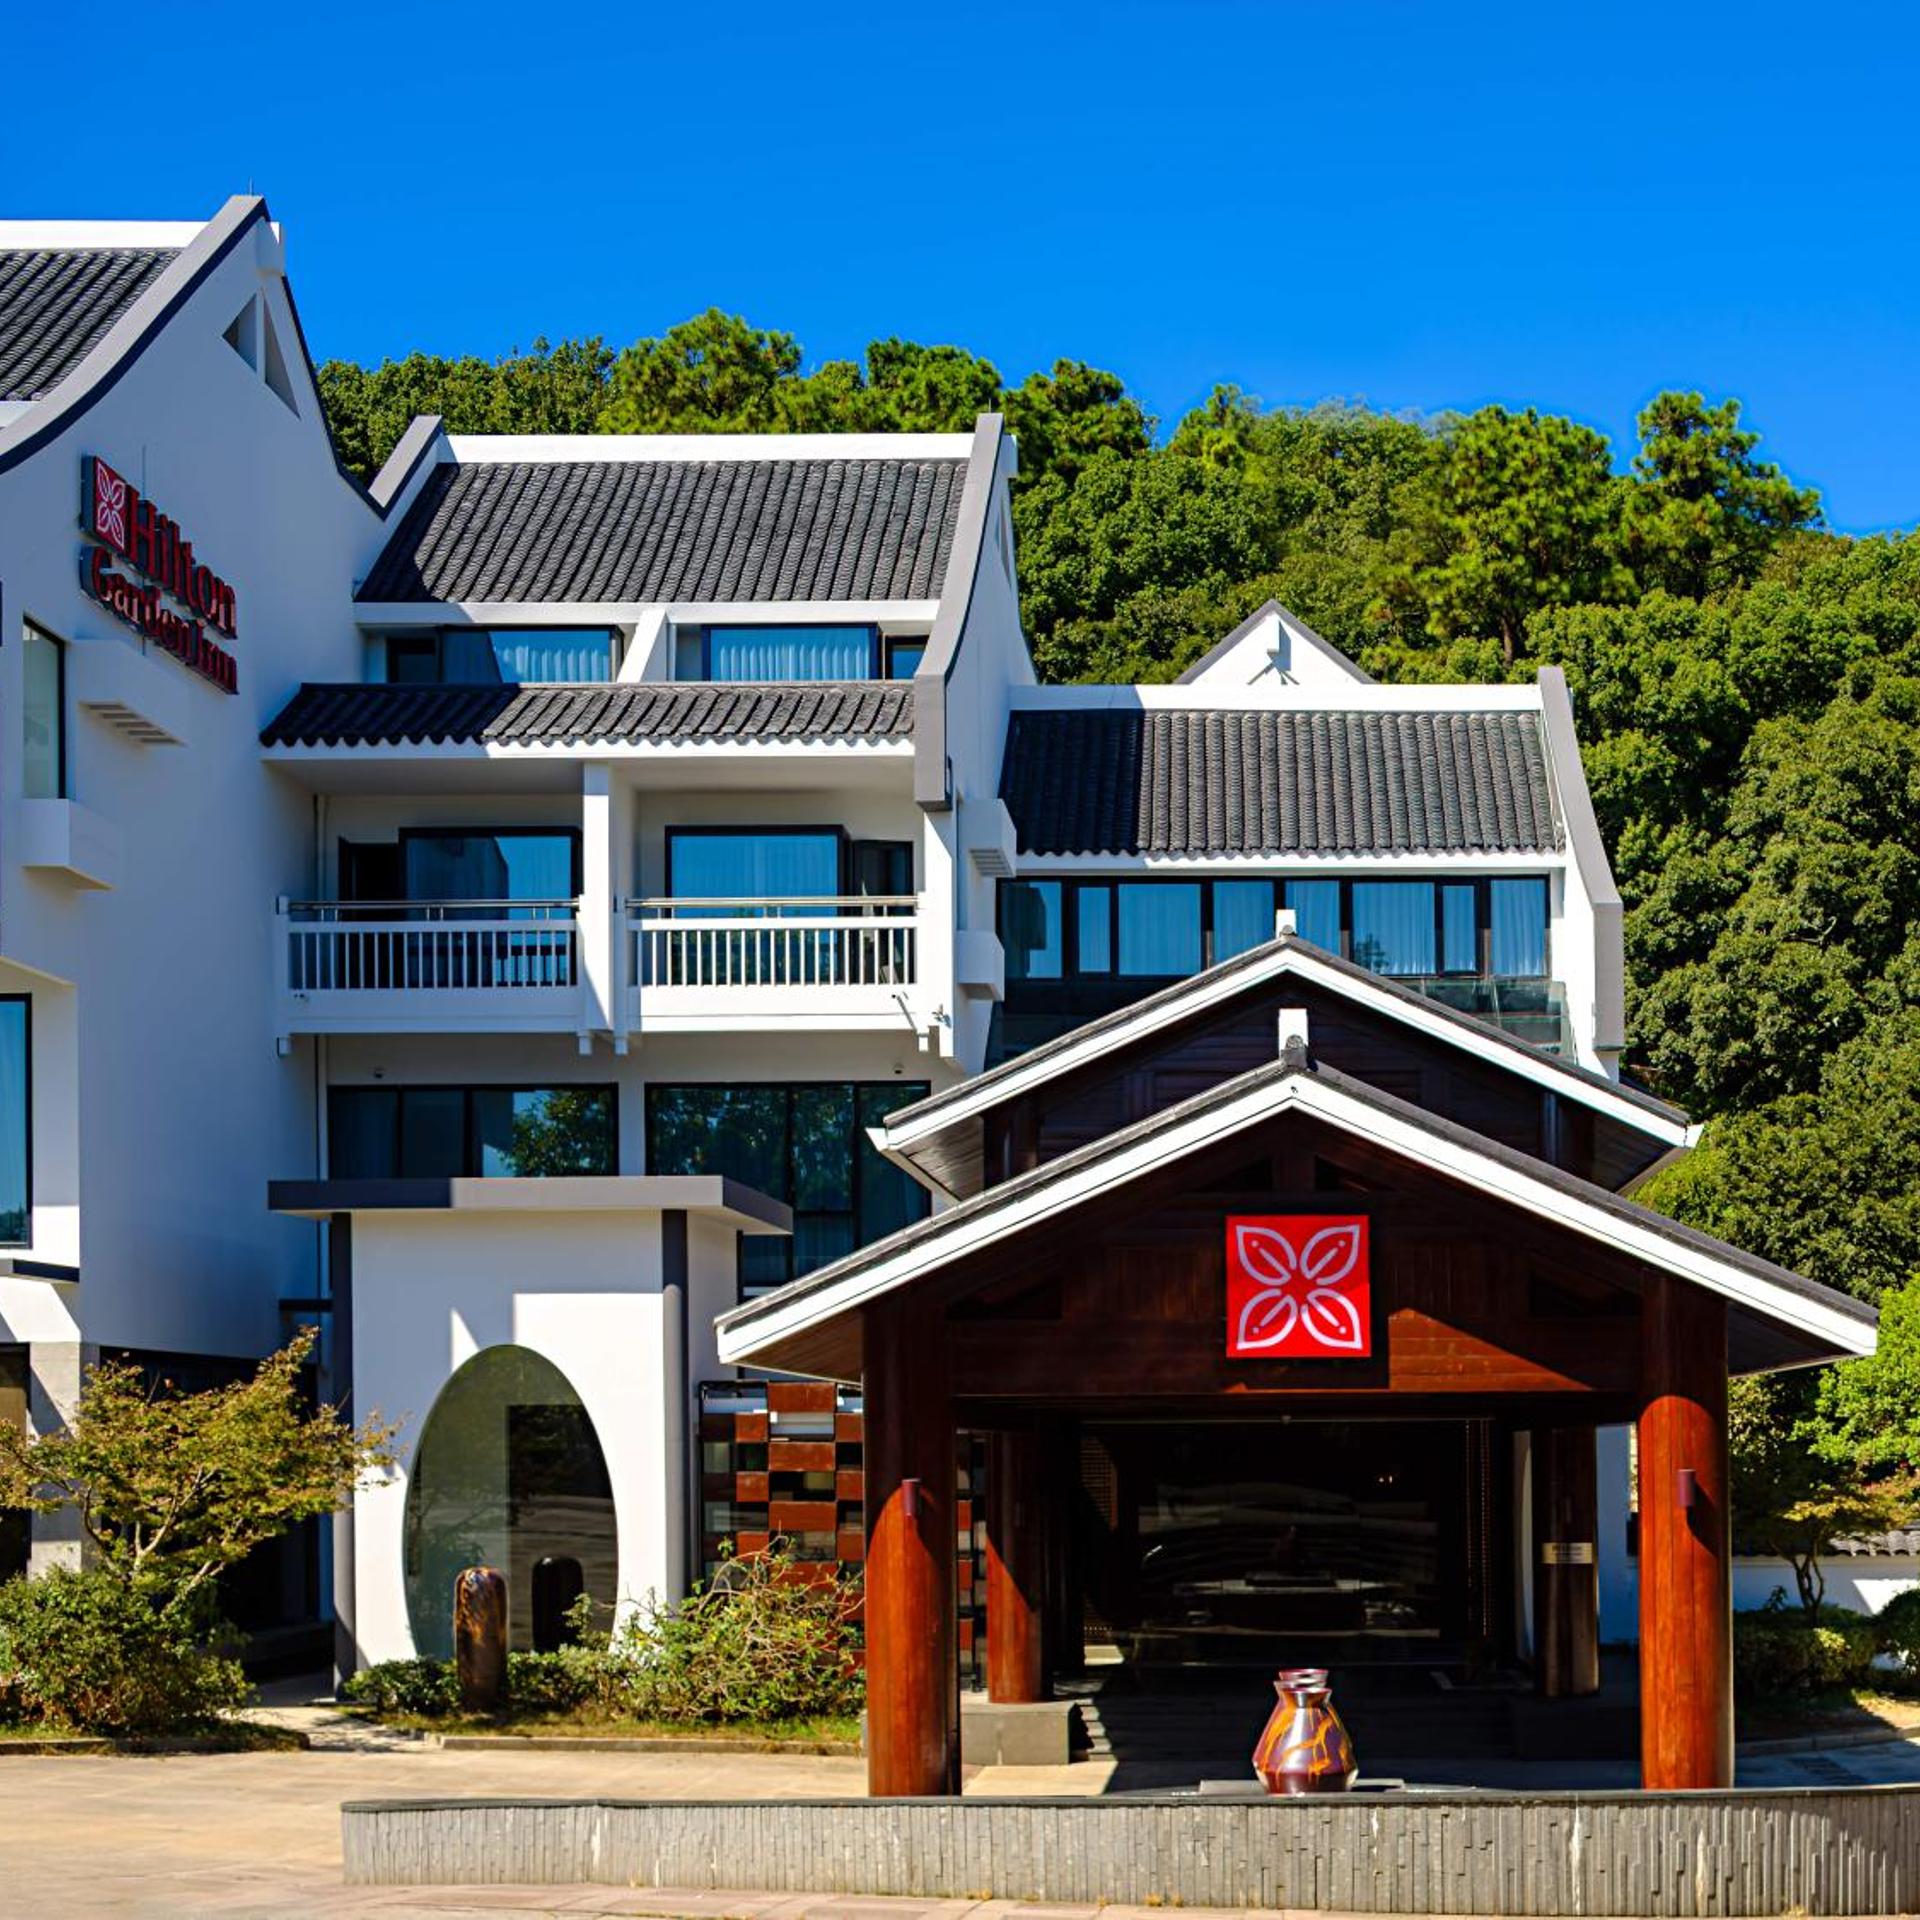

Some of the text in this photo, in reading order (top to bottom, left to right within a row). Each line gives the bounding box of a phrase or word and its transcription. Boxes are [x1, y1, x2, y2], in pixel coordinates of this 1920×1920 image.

[90, 546, 237, 694] Garden Inn
[127, 483, 236, 639] Hilton
